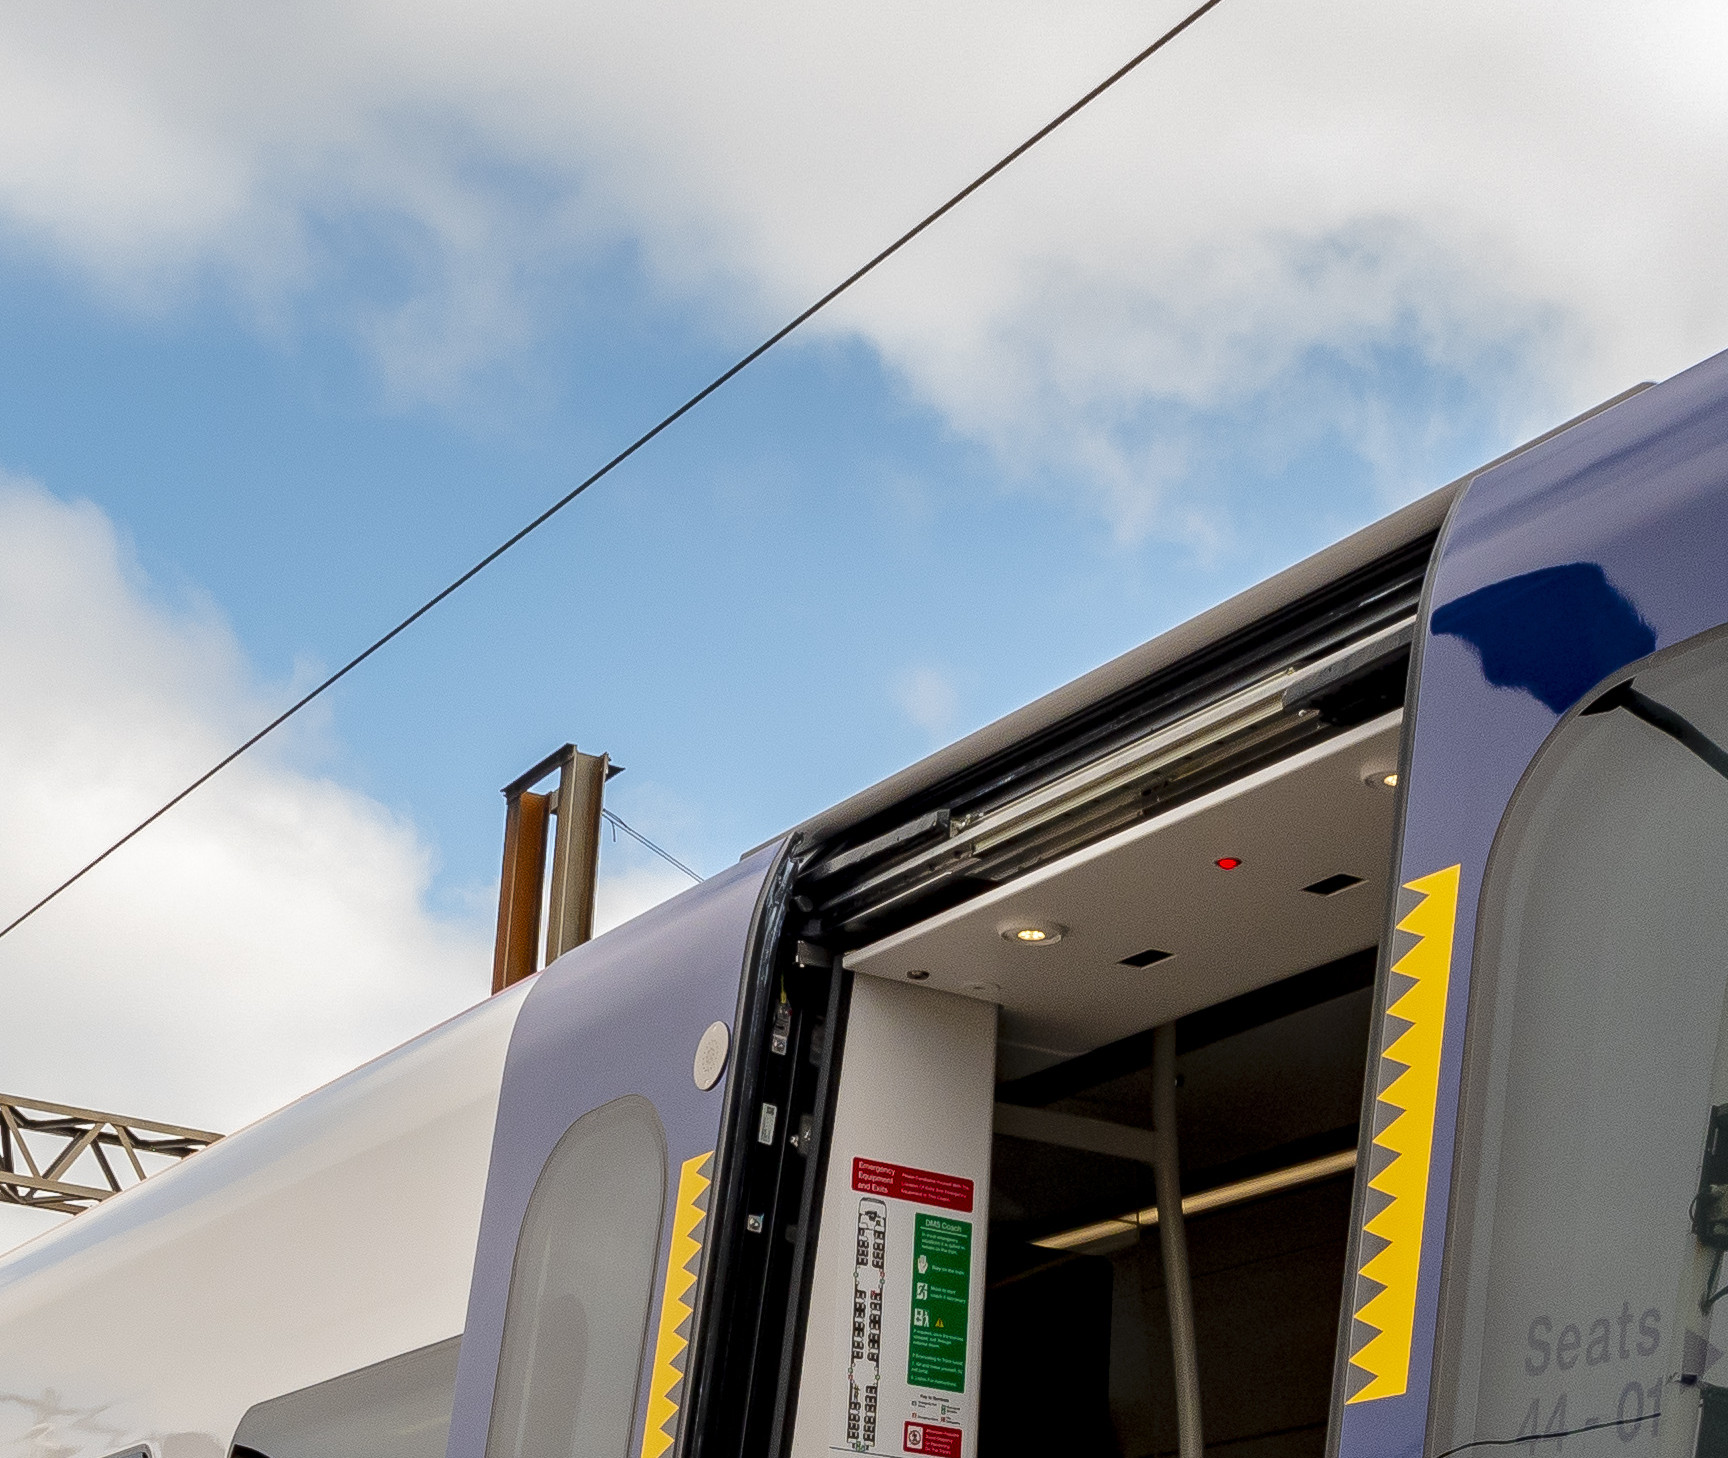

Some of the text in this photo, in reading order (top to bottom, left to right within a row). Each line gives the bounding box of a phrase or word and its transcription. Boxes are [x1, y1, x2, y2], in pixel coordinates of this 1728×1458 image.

[858, 1161, 895, 1176] Emergency
[858, 1171, 894, 1184] Equipment
[872, 1184, 888, 1193] Exits
[925, 1219, 962, 1232] DMS Coach
[1525, 1301, 1662, 1376] Seats
[1515, 1392, 1568, 1456] 44
[1617, 1374, 1664, 1443] 01
